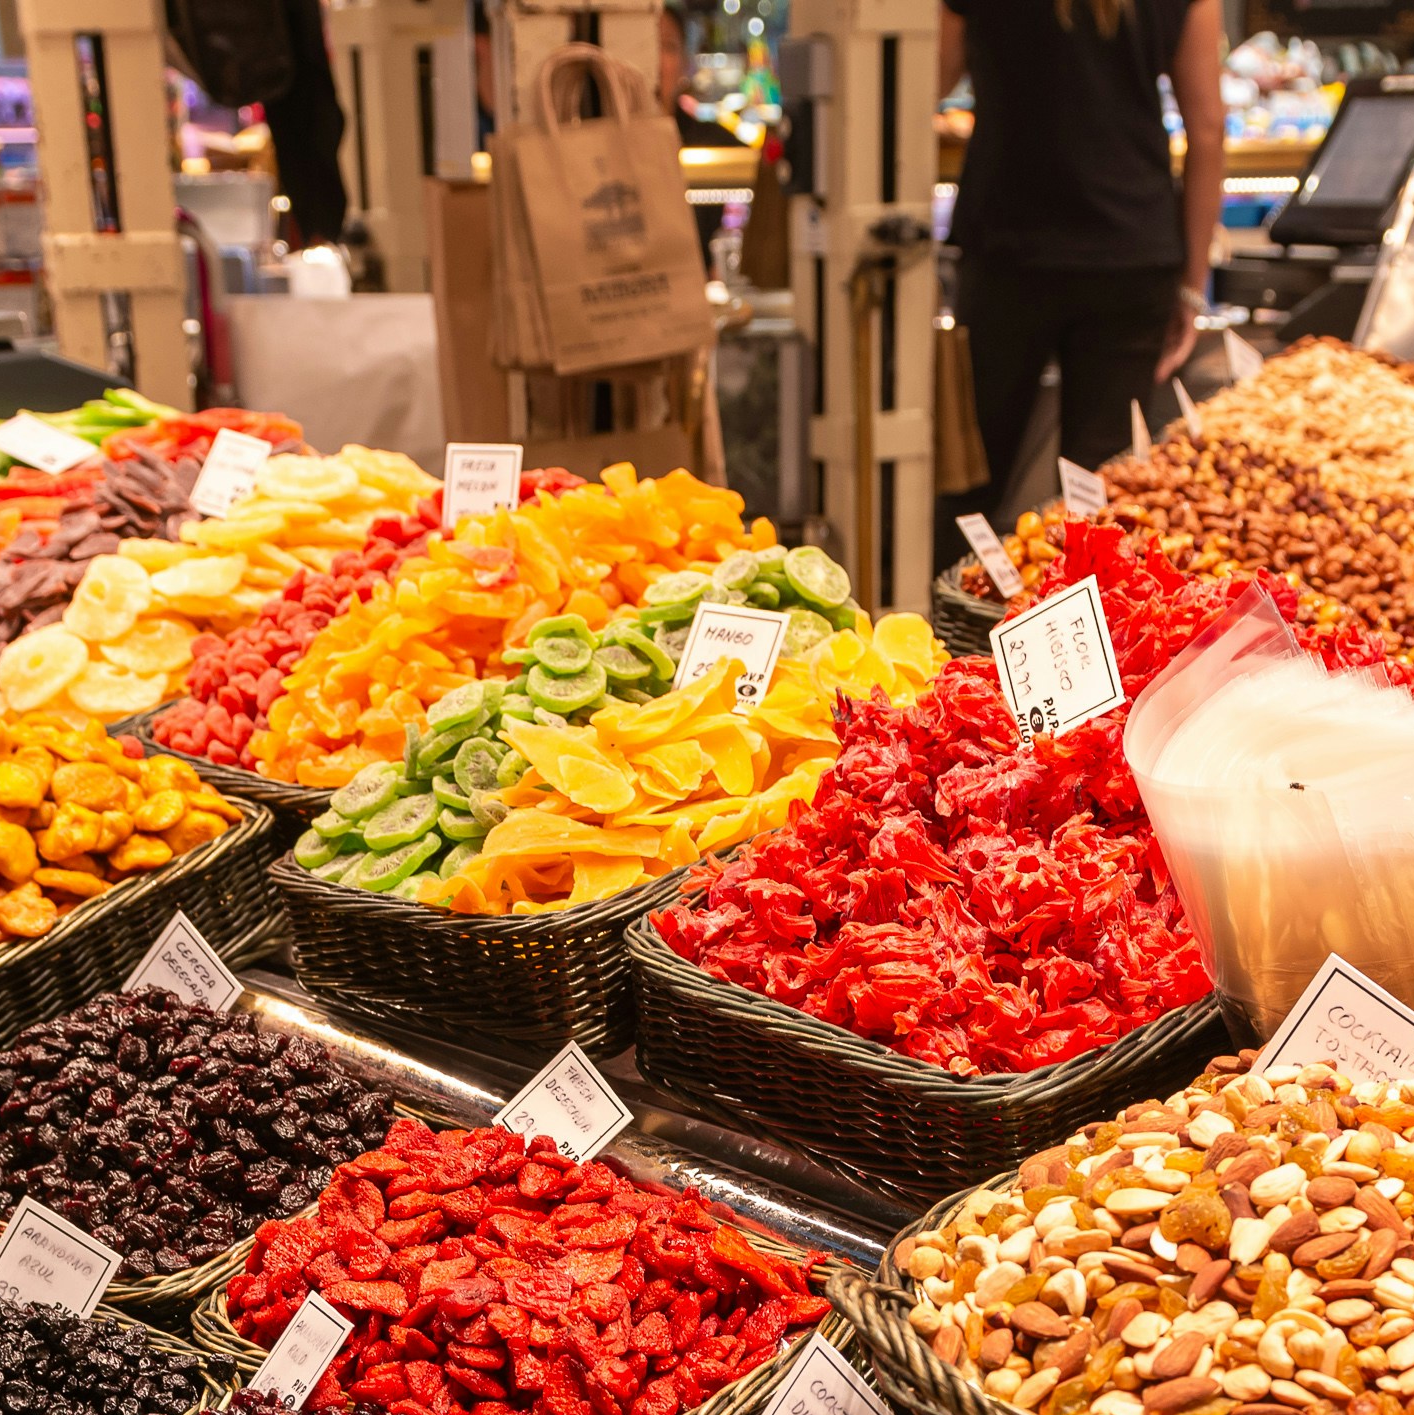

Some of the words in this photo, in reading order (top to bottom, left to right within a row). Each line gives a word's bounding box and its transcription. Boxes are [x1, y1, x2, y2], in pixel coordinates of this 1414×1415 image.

[704, 626, 754, 646] MANGO
[1070, 616, 1091, 670] FLOR
[1016, 713, 1032, 744] KILO
[175, 941, 216, 989] CEREZA
[1315, 1025, 1398, 1084] TOSTAD
[545, 1078, 591, 1134] DESECADA
[564, 1065, 596, 1103] FRESA
